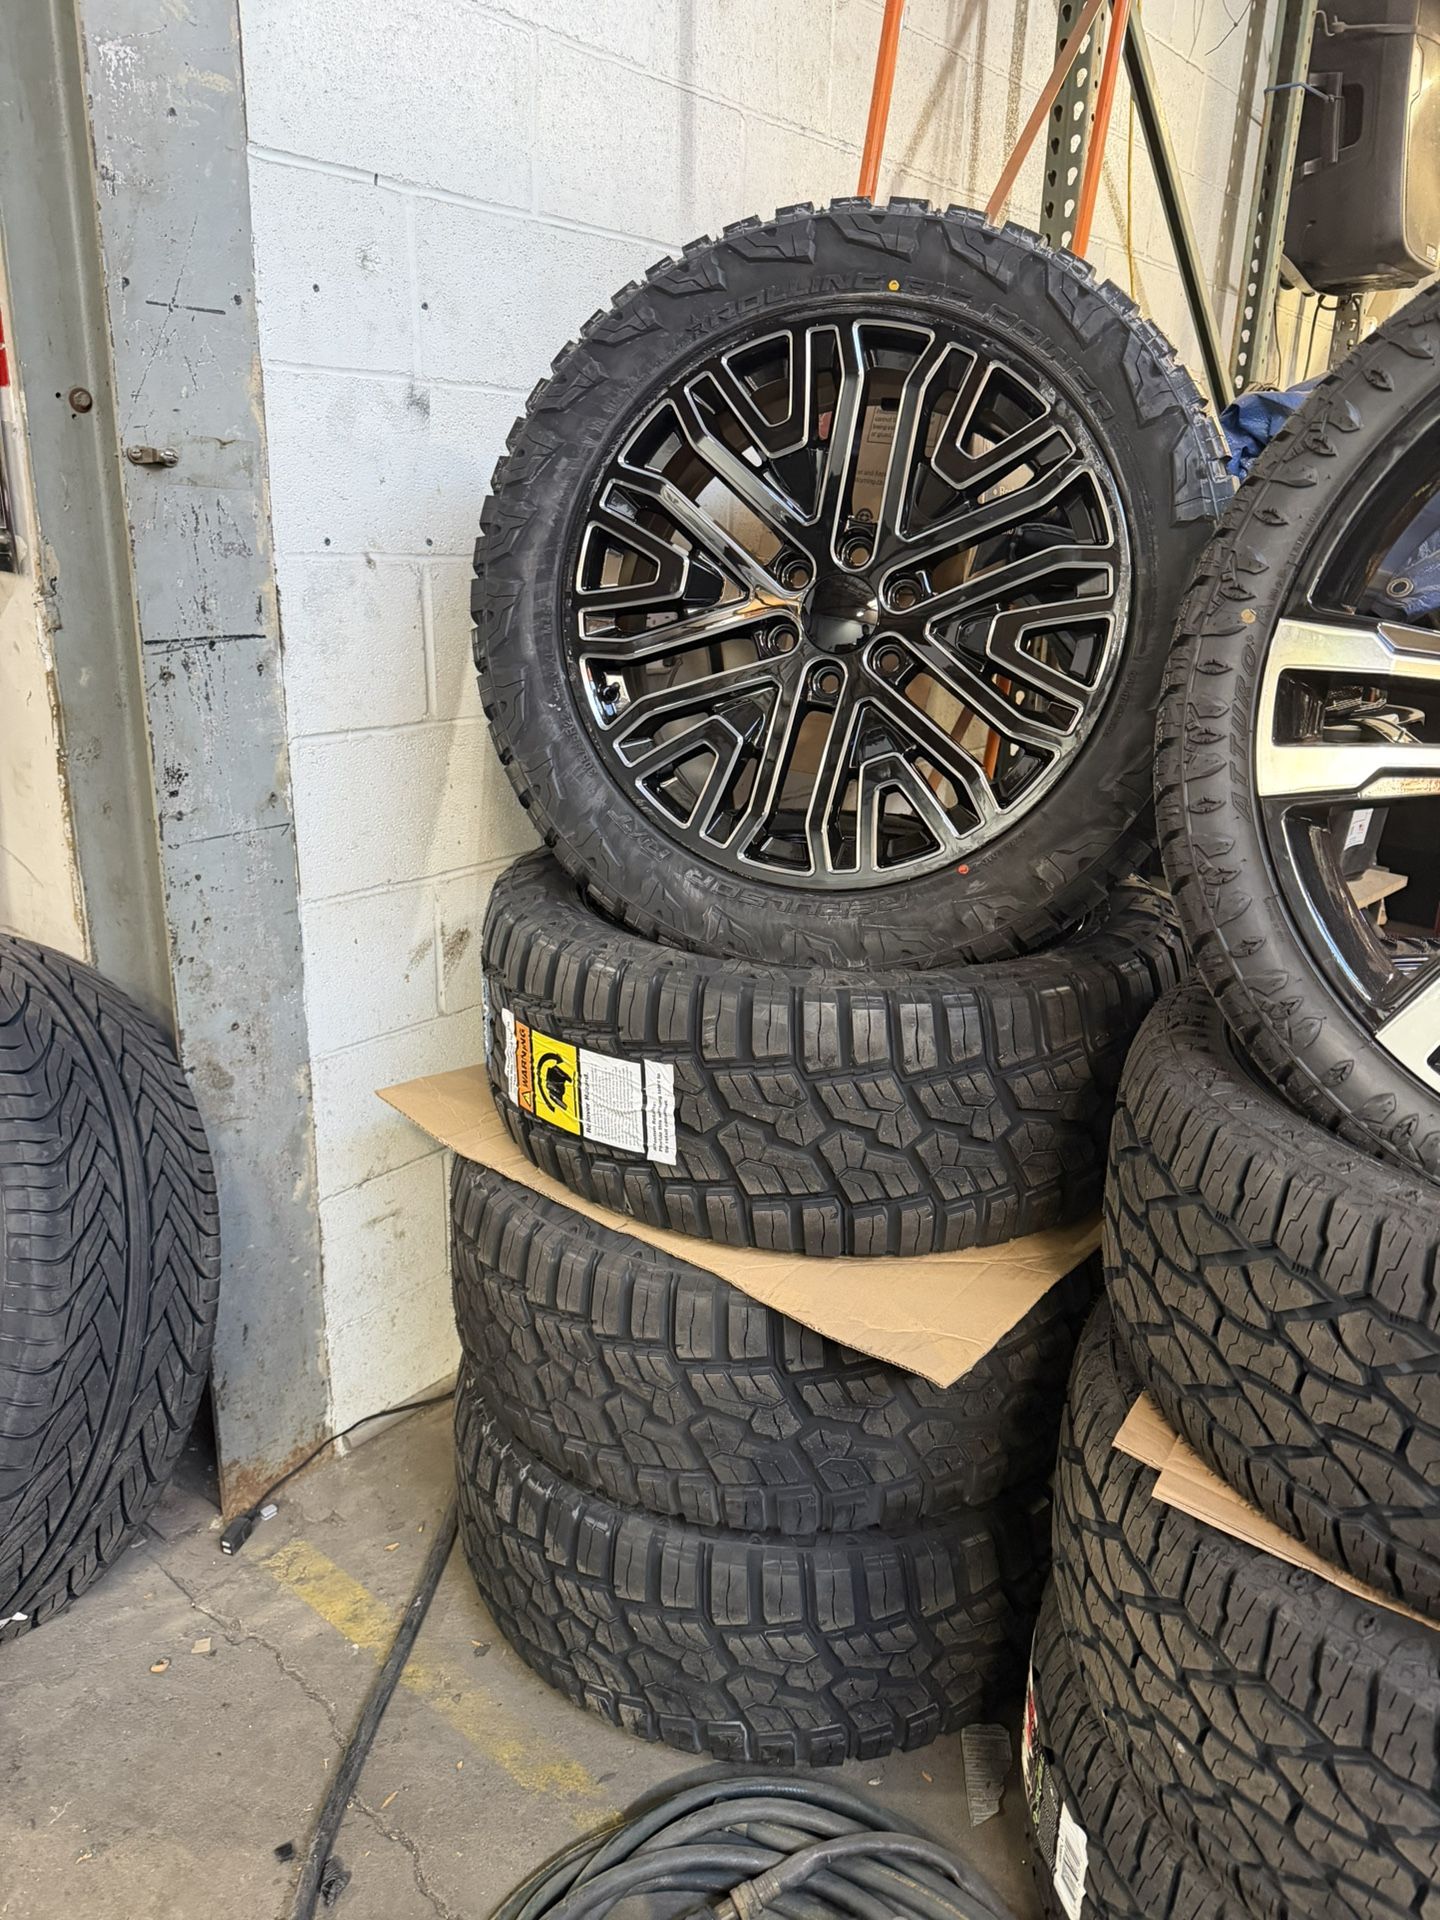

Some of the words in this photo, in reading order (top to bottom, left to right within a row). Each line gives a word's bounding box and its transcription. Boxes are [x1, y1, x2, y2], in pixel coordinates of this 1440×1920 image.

[708, 271, 887, 329] ROLLING
[982, 302, 1116, 421] POWER
[1230, 643, 1257, 823] ATTURO
[684, 868, 908, 919] REPULSOR
[519, 1028, 530, 1088] WARNING
